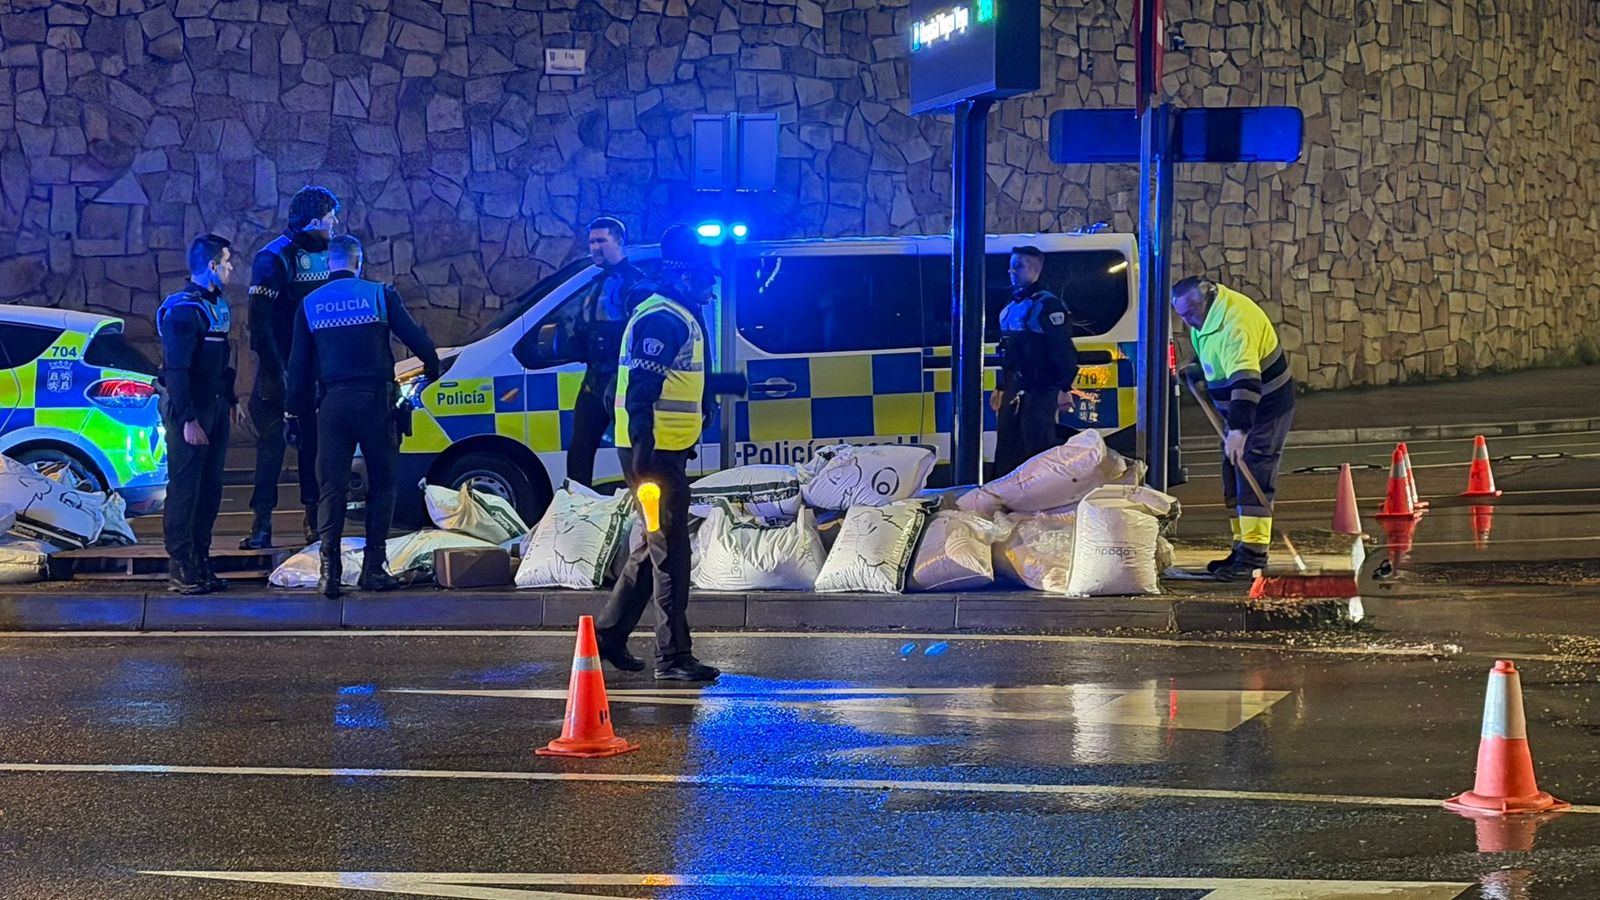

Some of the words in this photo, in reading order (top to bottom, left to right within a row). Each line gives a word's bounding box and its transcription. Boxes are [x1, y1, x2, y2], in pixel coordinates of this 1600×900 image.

[52, 346, 77, 357] 704
[1077, 373, 1097, 384] 719
[437, 390, 485, 405] Policía
[743, 440, 826, 465] Policí
